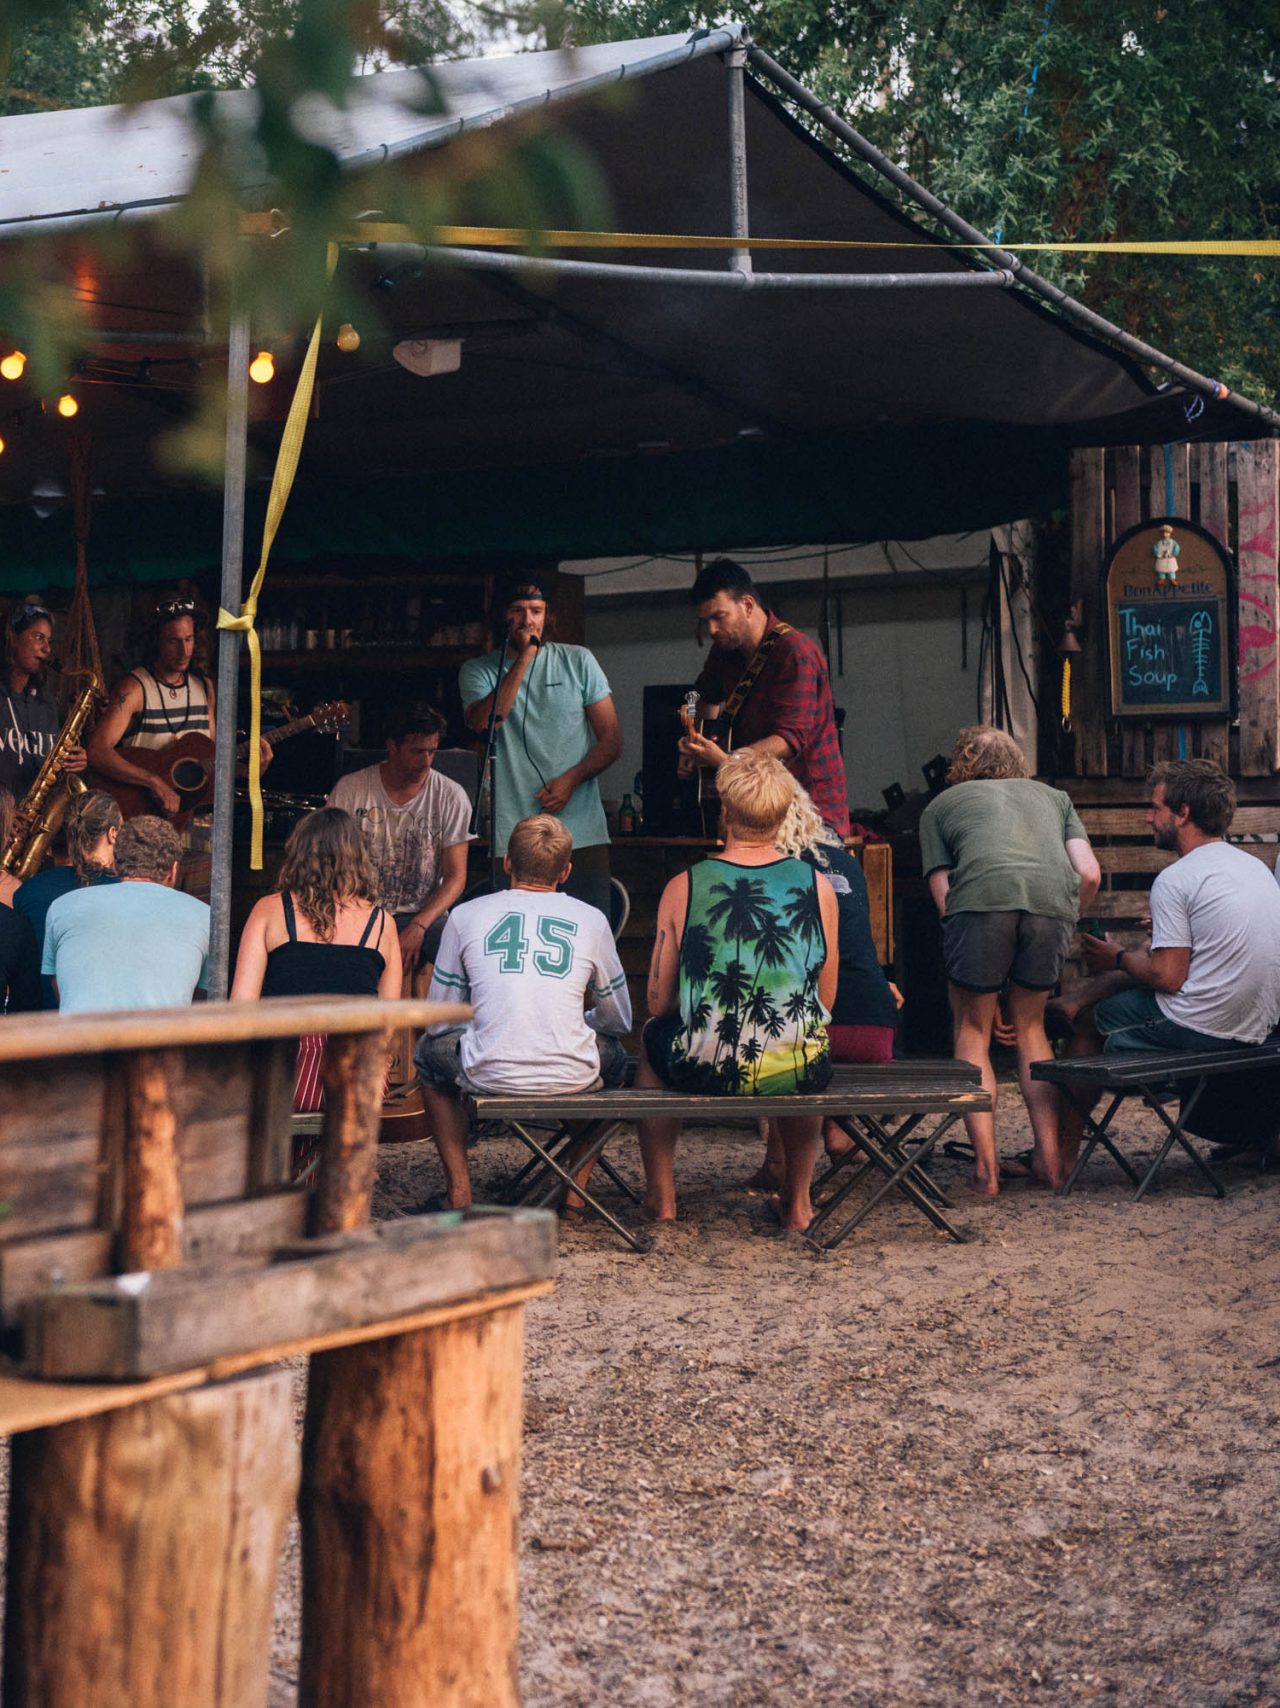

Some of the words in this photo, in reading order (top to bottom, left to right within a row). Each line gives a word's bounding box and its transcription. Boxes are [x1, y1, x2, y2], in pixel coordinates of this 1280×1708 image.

[1120, 608, 1162, 636] Thai
[1126, 638, 1166, 661] Fish
[1128, 665, 1178, 692] Soup
[484, 911, 578, 980] 45
